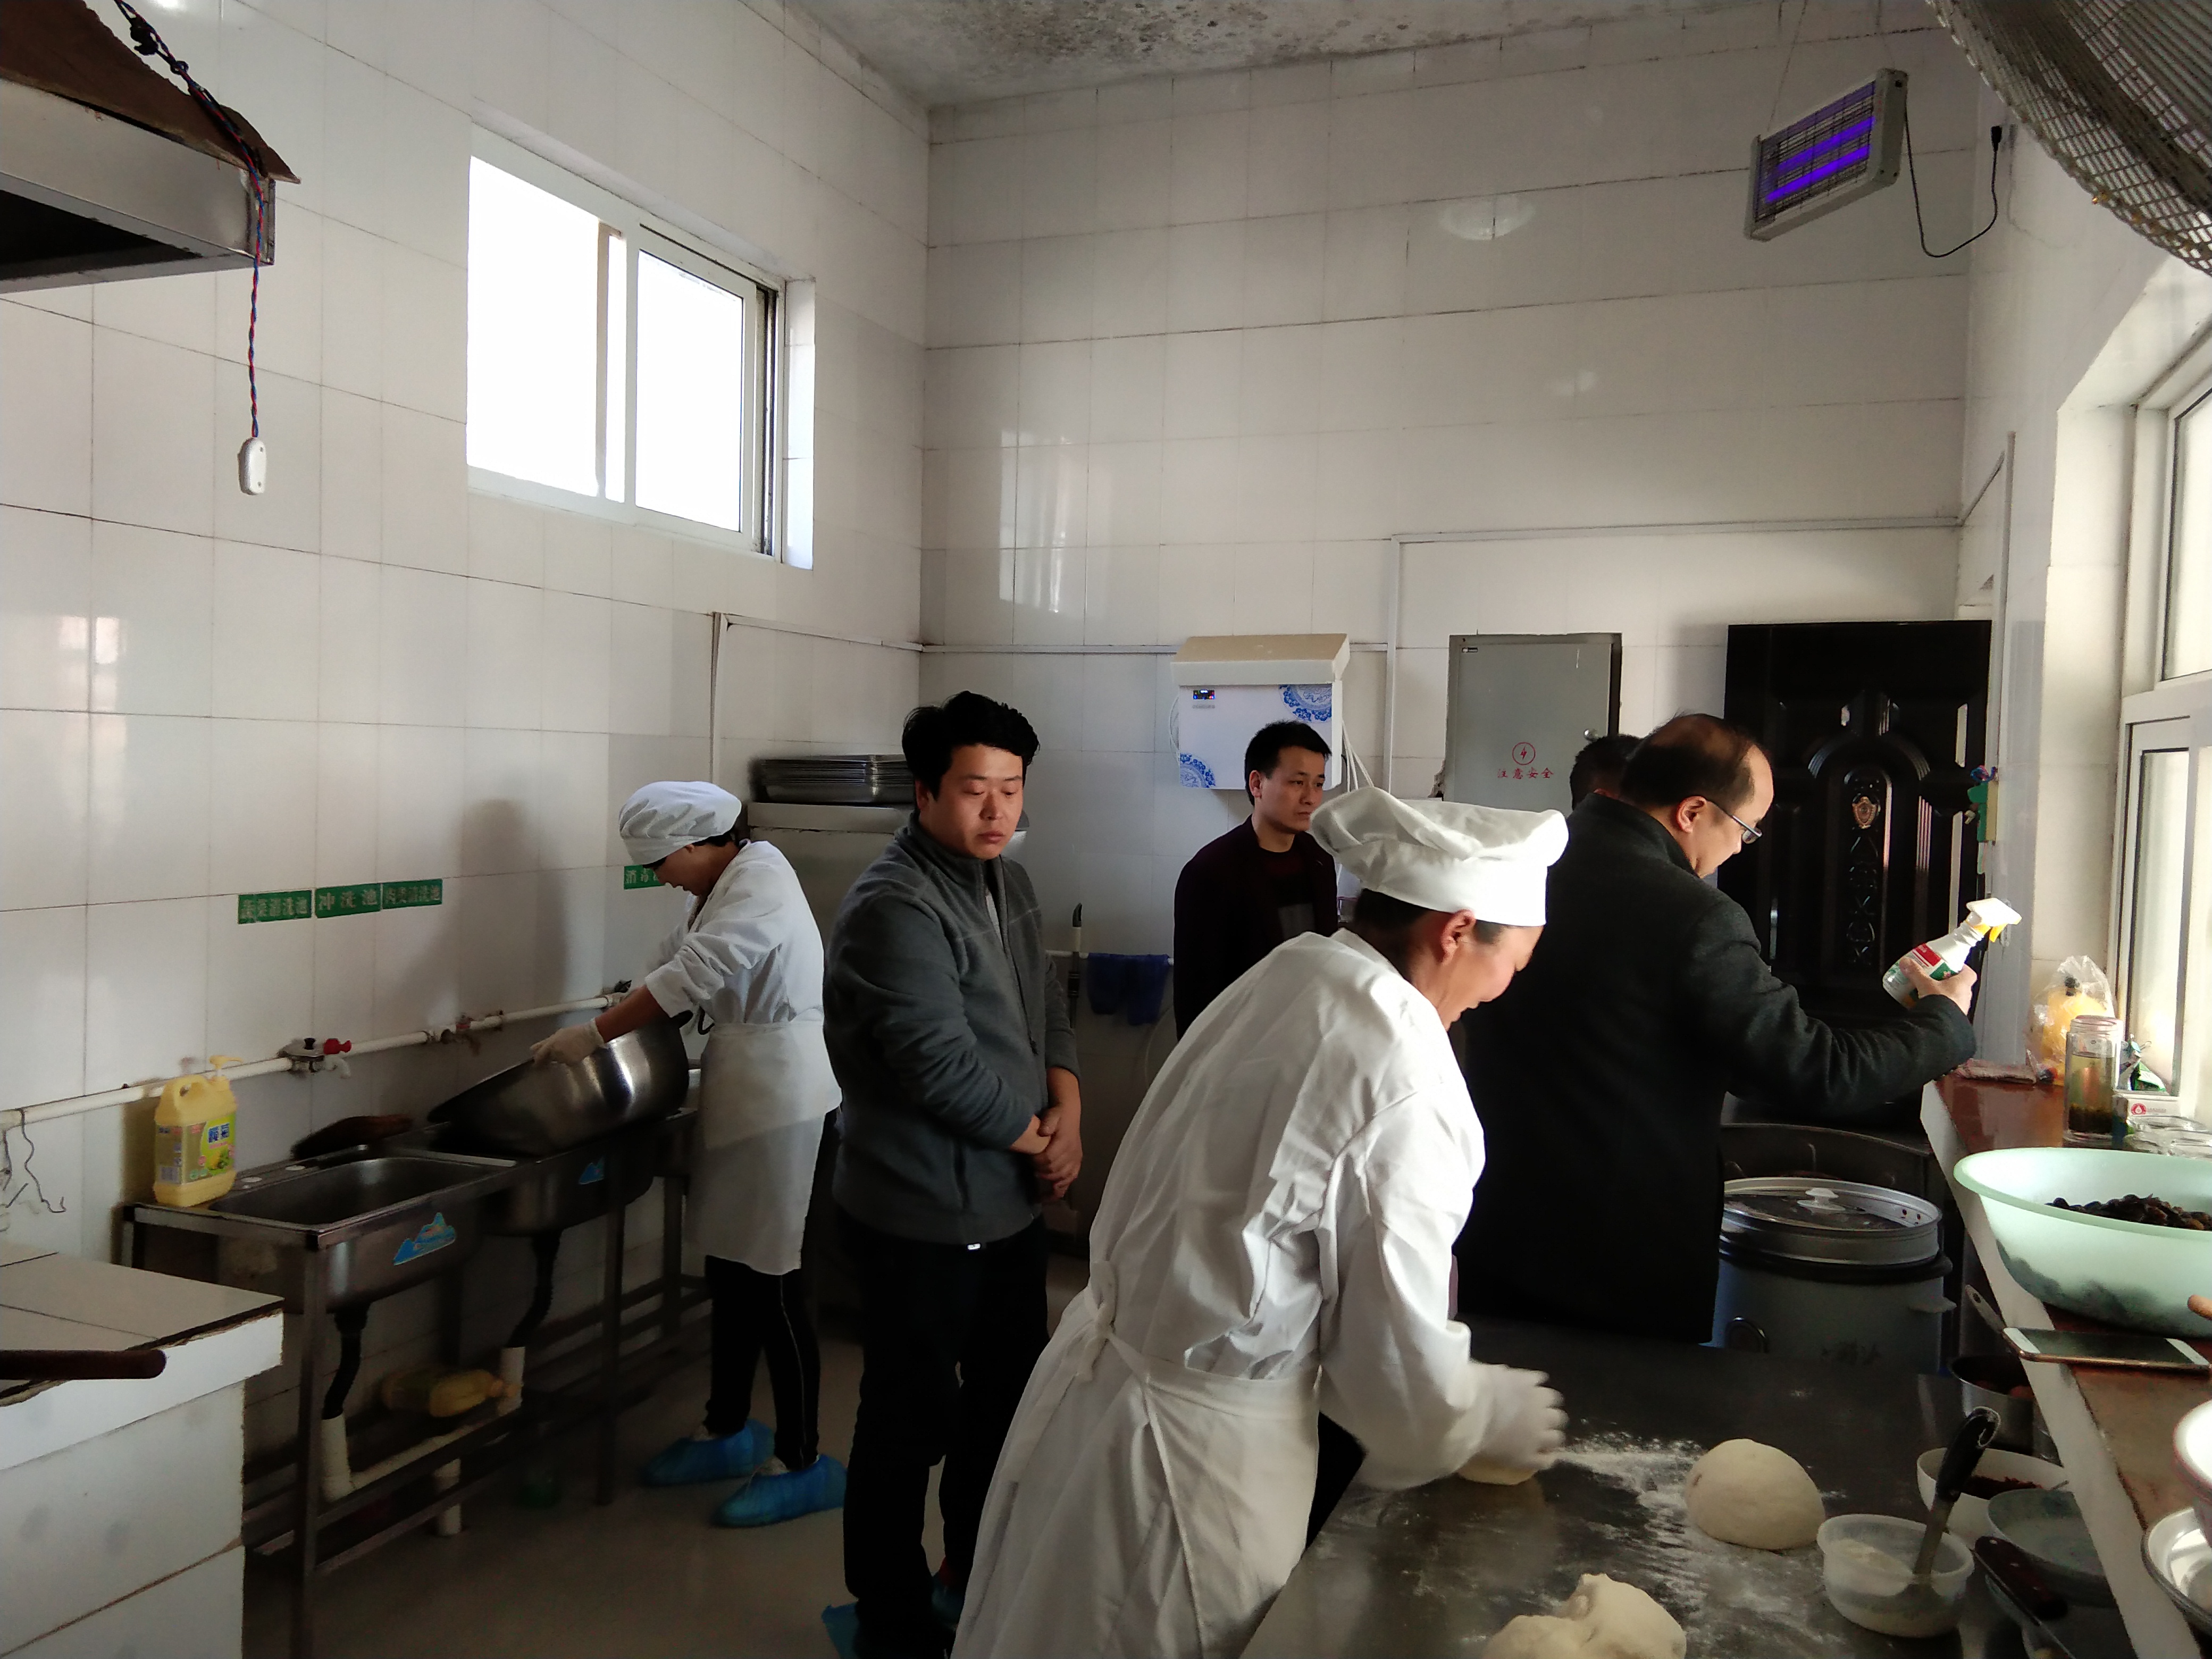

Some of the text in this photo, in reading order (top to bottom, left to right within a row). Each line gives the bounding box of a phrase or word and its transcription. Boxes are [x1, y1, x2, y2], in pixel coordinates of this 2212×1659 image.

[1497, 767, 1554, 780] 注意安全
[319, 889, 378, 910] 冲洗池
